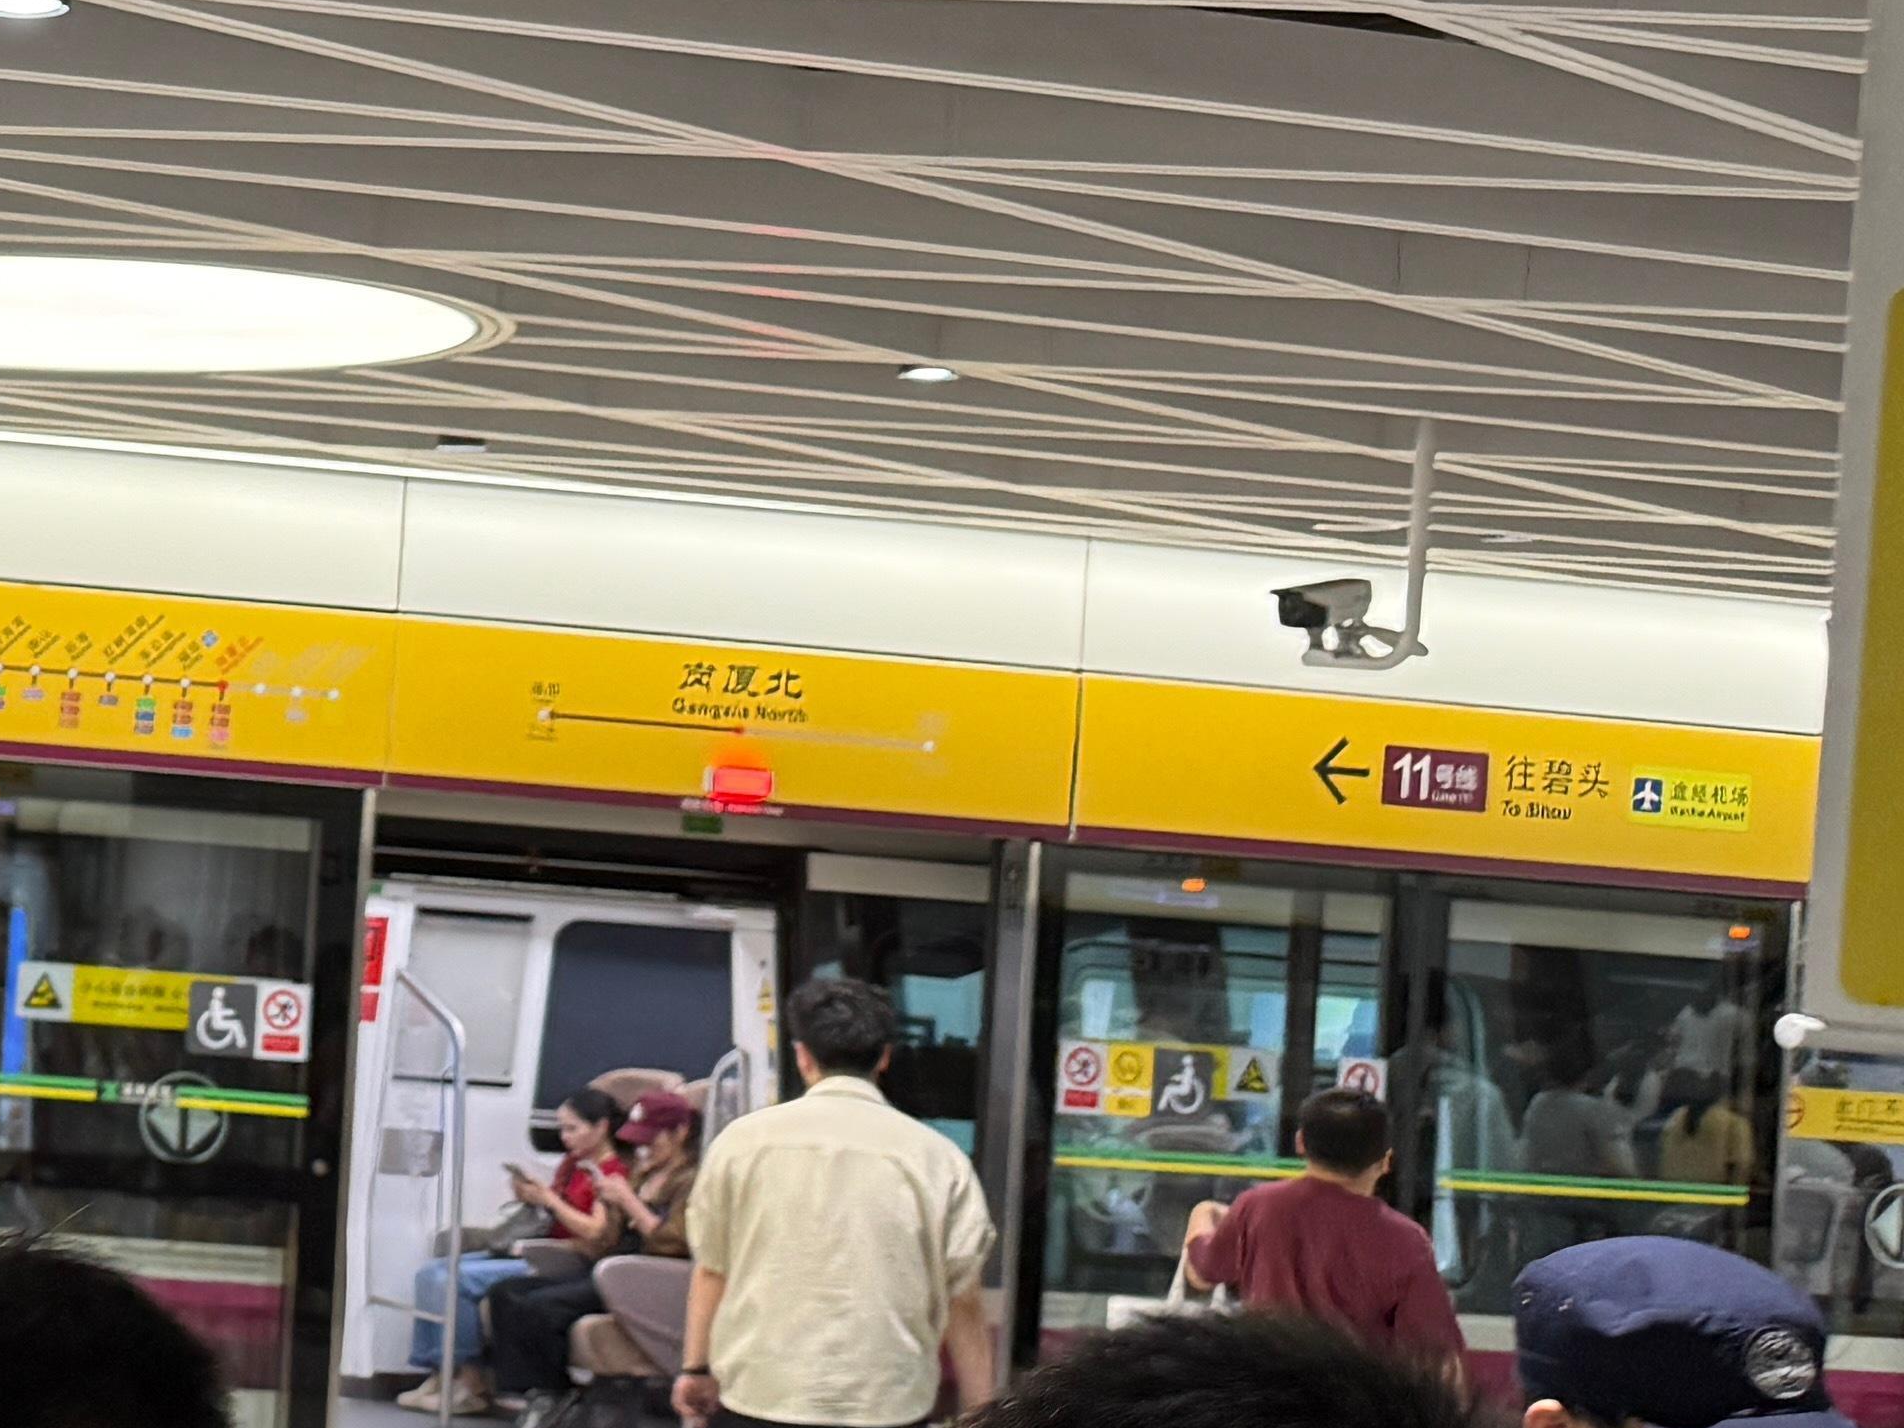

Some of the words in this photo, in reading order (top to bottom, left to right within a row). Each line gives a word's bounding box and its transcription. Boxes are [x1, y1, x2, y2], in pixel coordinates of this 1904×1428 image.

[678, 661, 803, 700] 岗厦北
[1504, 755, 1610, 800] 往碧头
